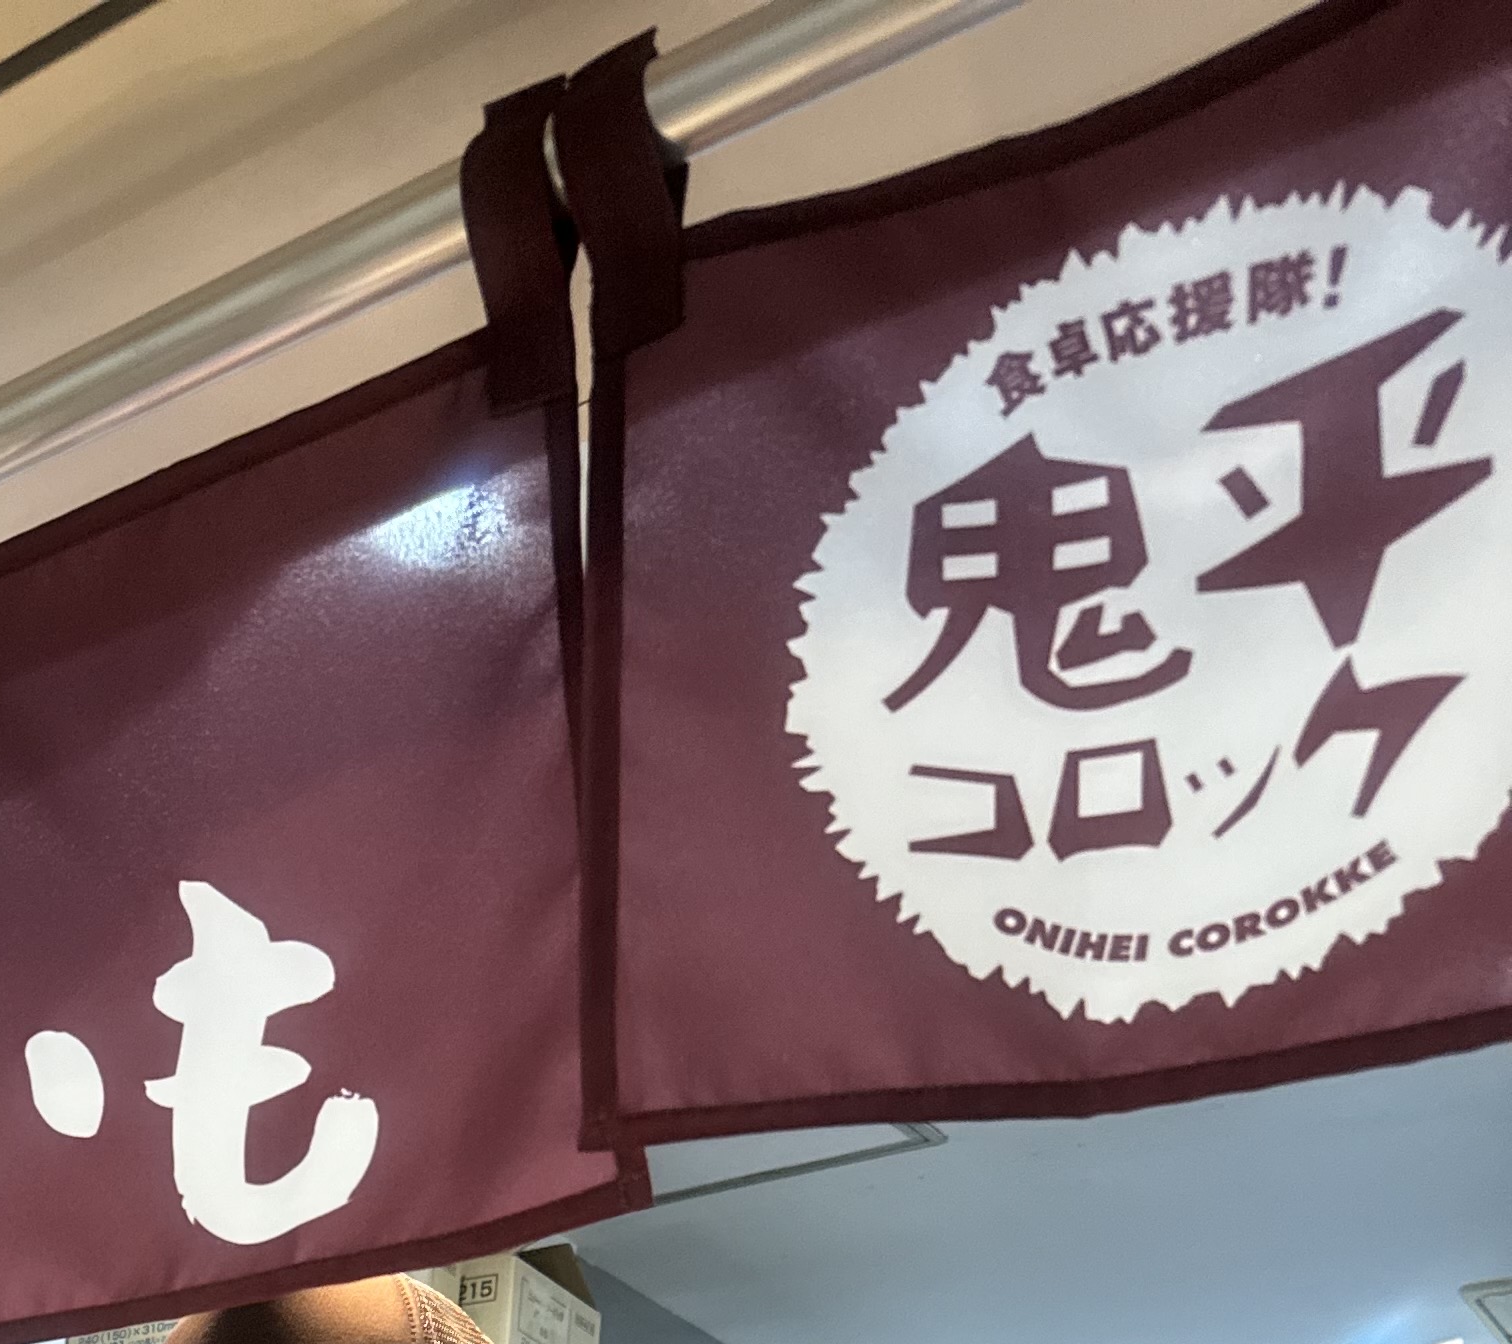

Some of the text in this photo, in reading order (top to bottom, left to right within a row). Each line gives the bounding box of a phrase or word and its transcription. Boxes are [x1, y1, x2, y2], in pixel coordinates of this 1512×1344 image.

[986, 244, 1351, 419] 食卓応援隊!
[882, 306, 1494, 713] 鬼平
[908, 655, 1471, 864] コロッケ
[992, 840, 1399, 963] ONIHEI COROKKE
